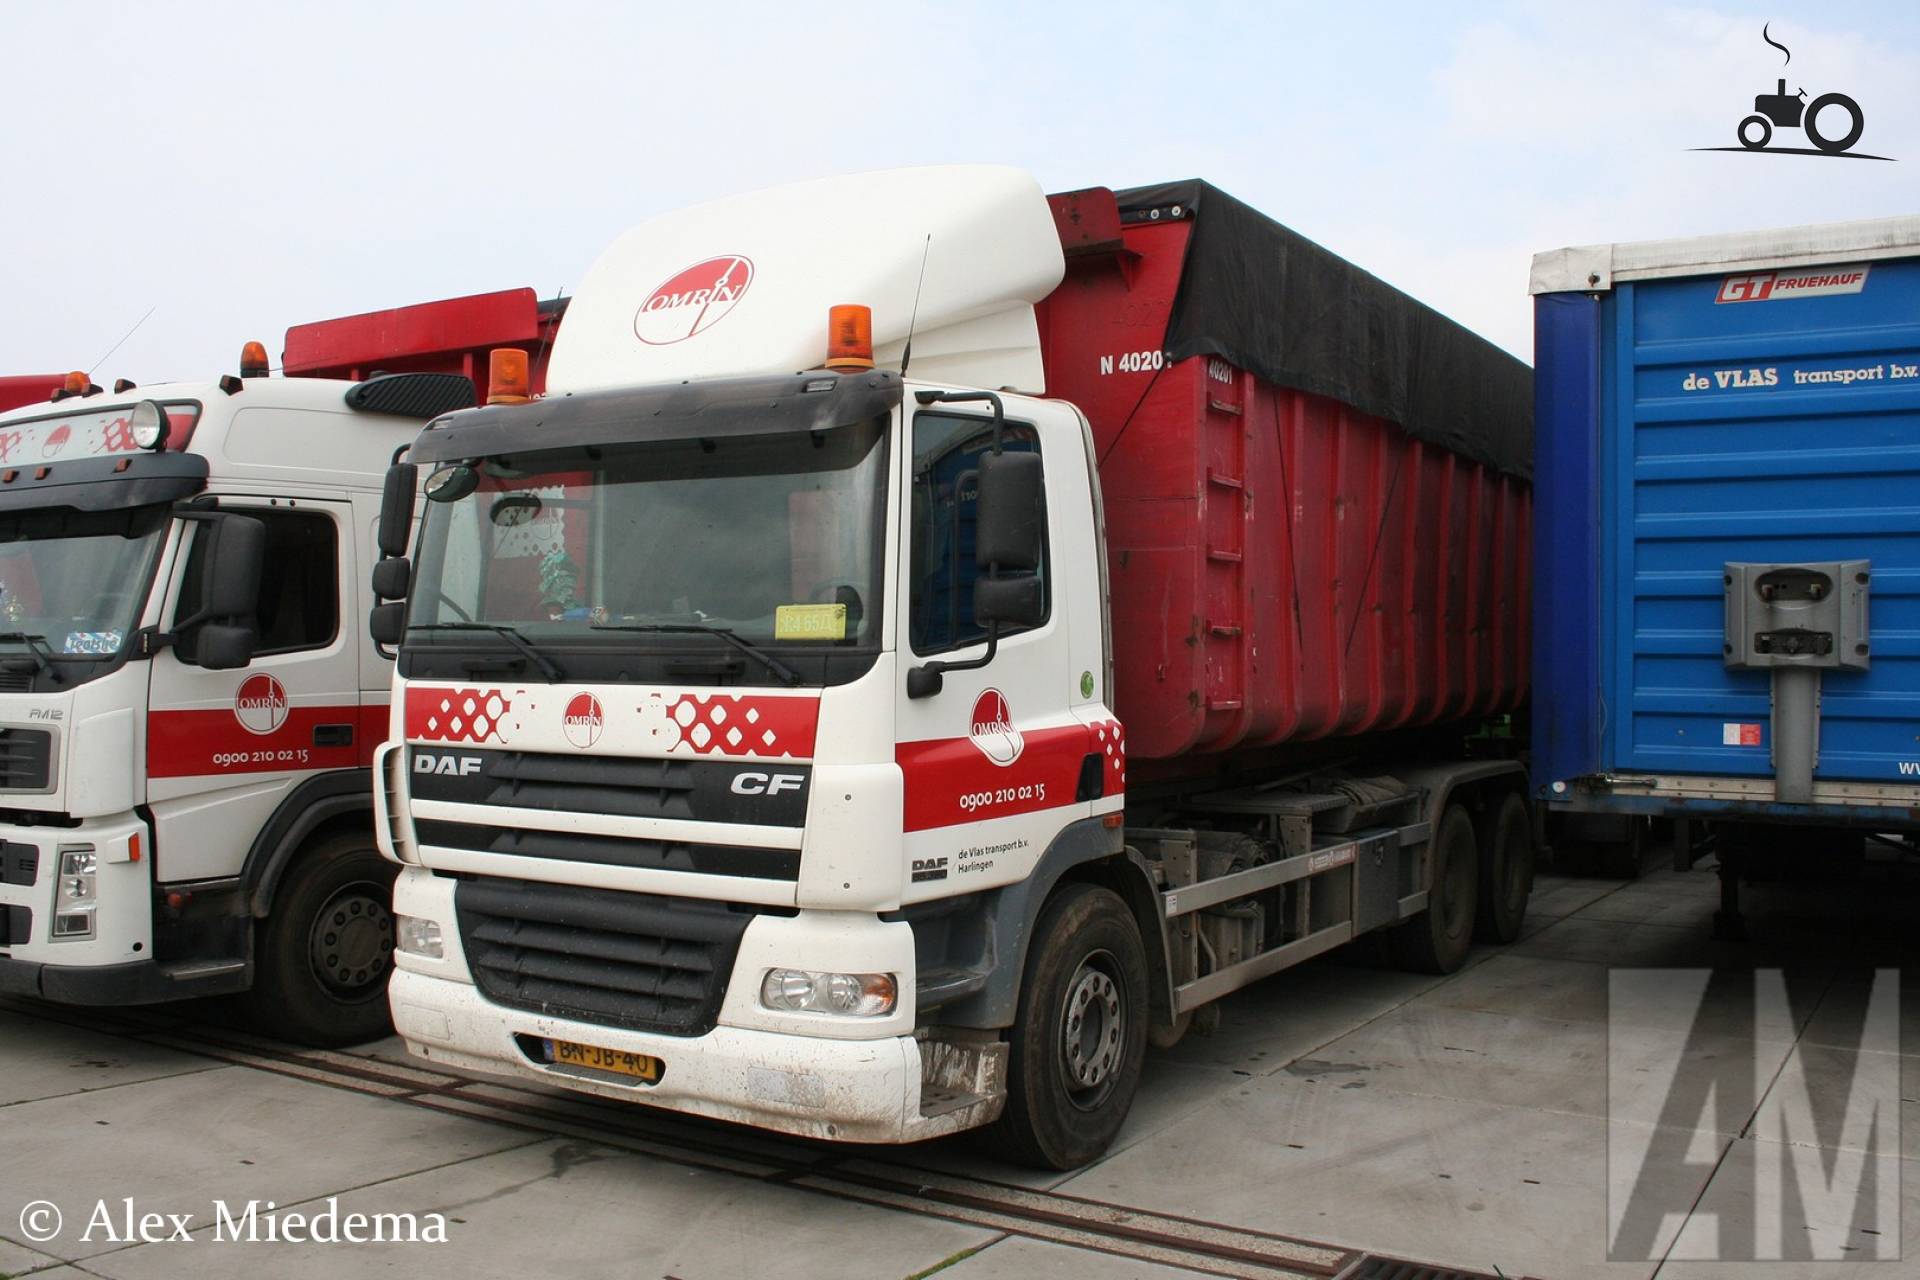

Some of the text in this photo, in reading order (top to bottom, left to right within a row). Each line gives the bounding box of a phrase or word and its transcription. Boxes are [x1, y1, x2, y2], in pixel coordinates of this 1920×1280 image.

[1721, 272, 1864, 301] GT FRUEHAUF
[645, 284, 743, 312] OMRIN
[1100, 355, 1114, 376] N
[1208, 359, 1233, 385] 40201
[1682, 373, 1710, 391] de
[1714, 368, 1779, 389] VLAS
[1793, 364, 1884, 385] transport
[239, 697, 285, 709] OMRIN
[30, 709, 64, 720] FM12
[565, 715, 602, 727] OMRIN
[972, 721, 1014, 737] OMRIN
[212, 749, 309, 766] 0900 210 02 15
[414, 755, 482, 776] DAF
[730, 772, 805, 795] CF
[960, 783, 1045, 812] 0900 210 02 15
[958, 848, 968, 860] de
[969, 846, 985, 858] Vlas
[985, 840, 1017, 854] transport
[912, 857, 948, 871] DAF
[958, 860, 994, 874] Harlingen
